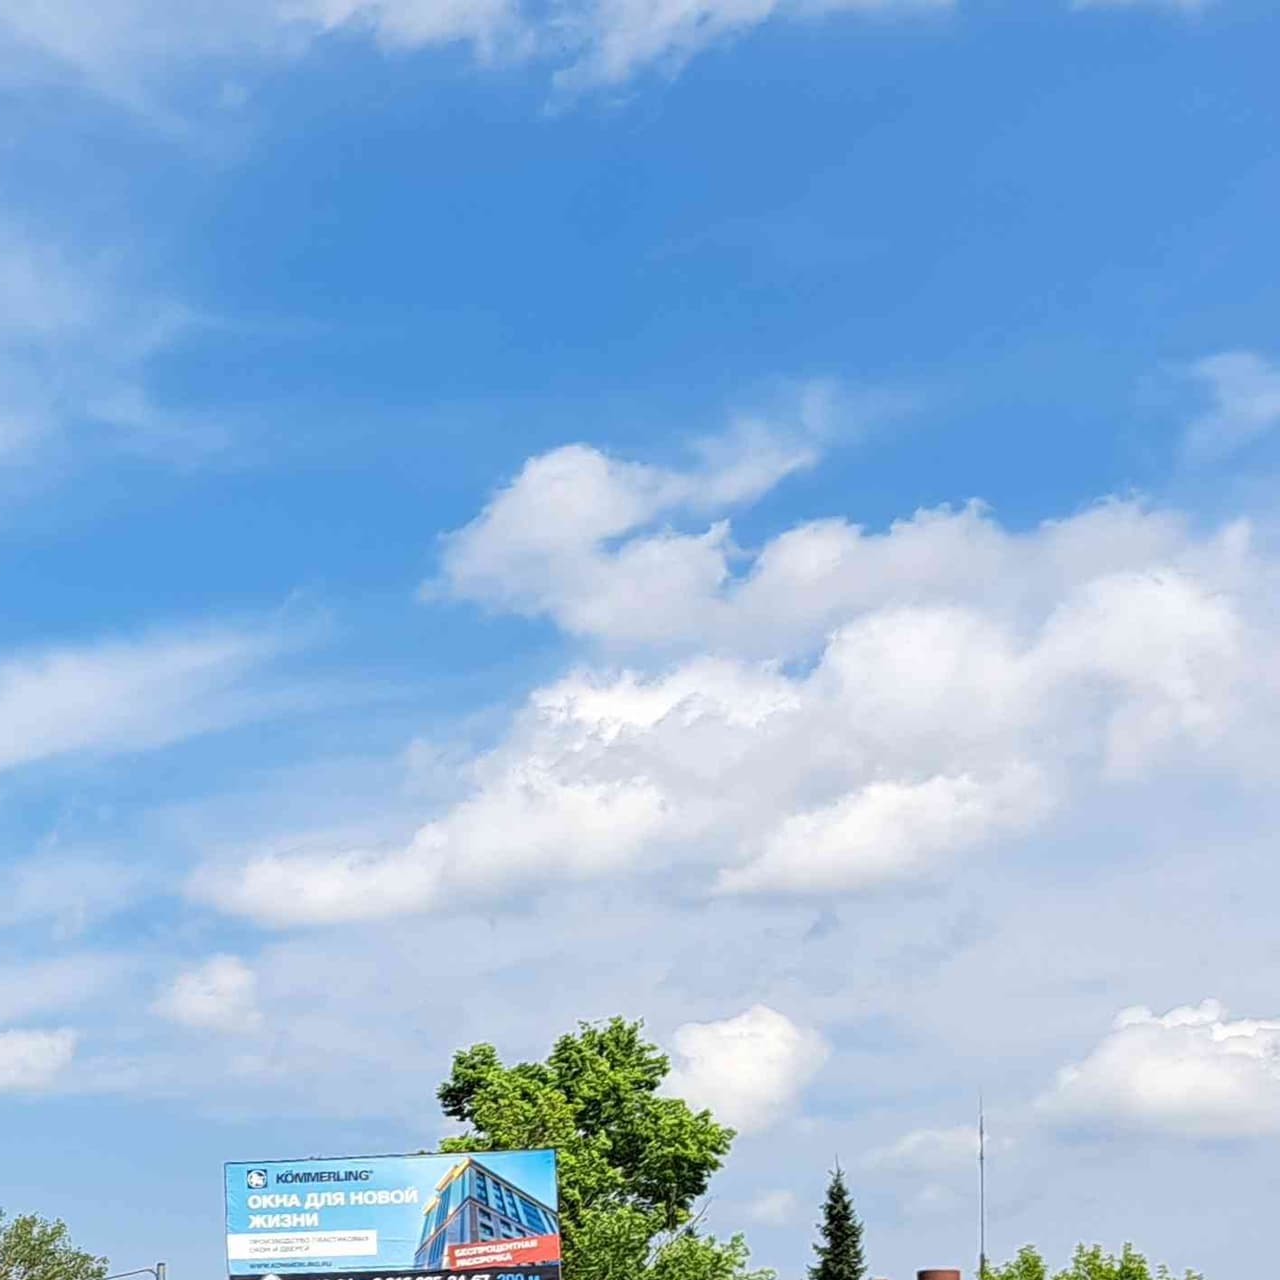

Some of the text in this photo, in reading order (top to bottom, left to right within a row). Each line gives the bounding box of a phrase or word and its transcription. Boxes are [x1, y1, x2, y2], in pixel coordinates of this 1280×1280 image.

[247, 1188, 419, 1209] ОКНА ДЛЯ НОВОЙ
[248, 1213, 319, 1229] ЖИЗНИ
